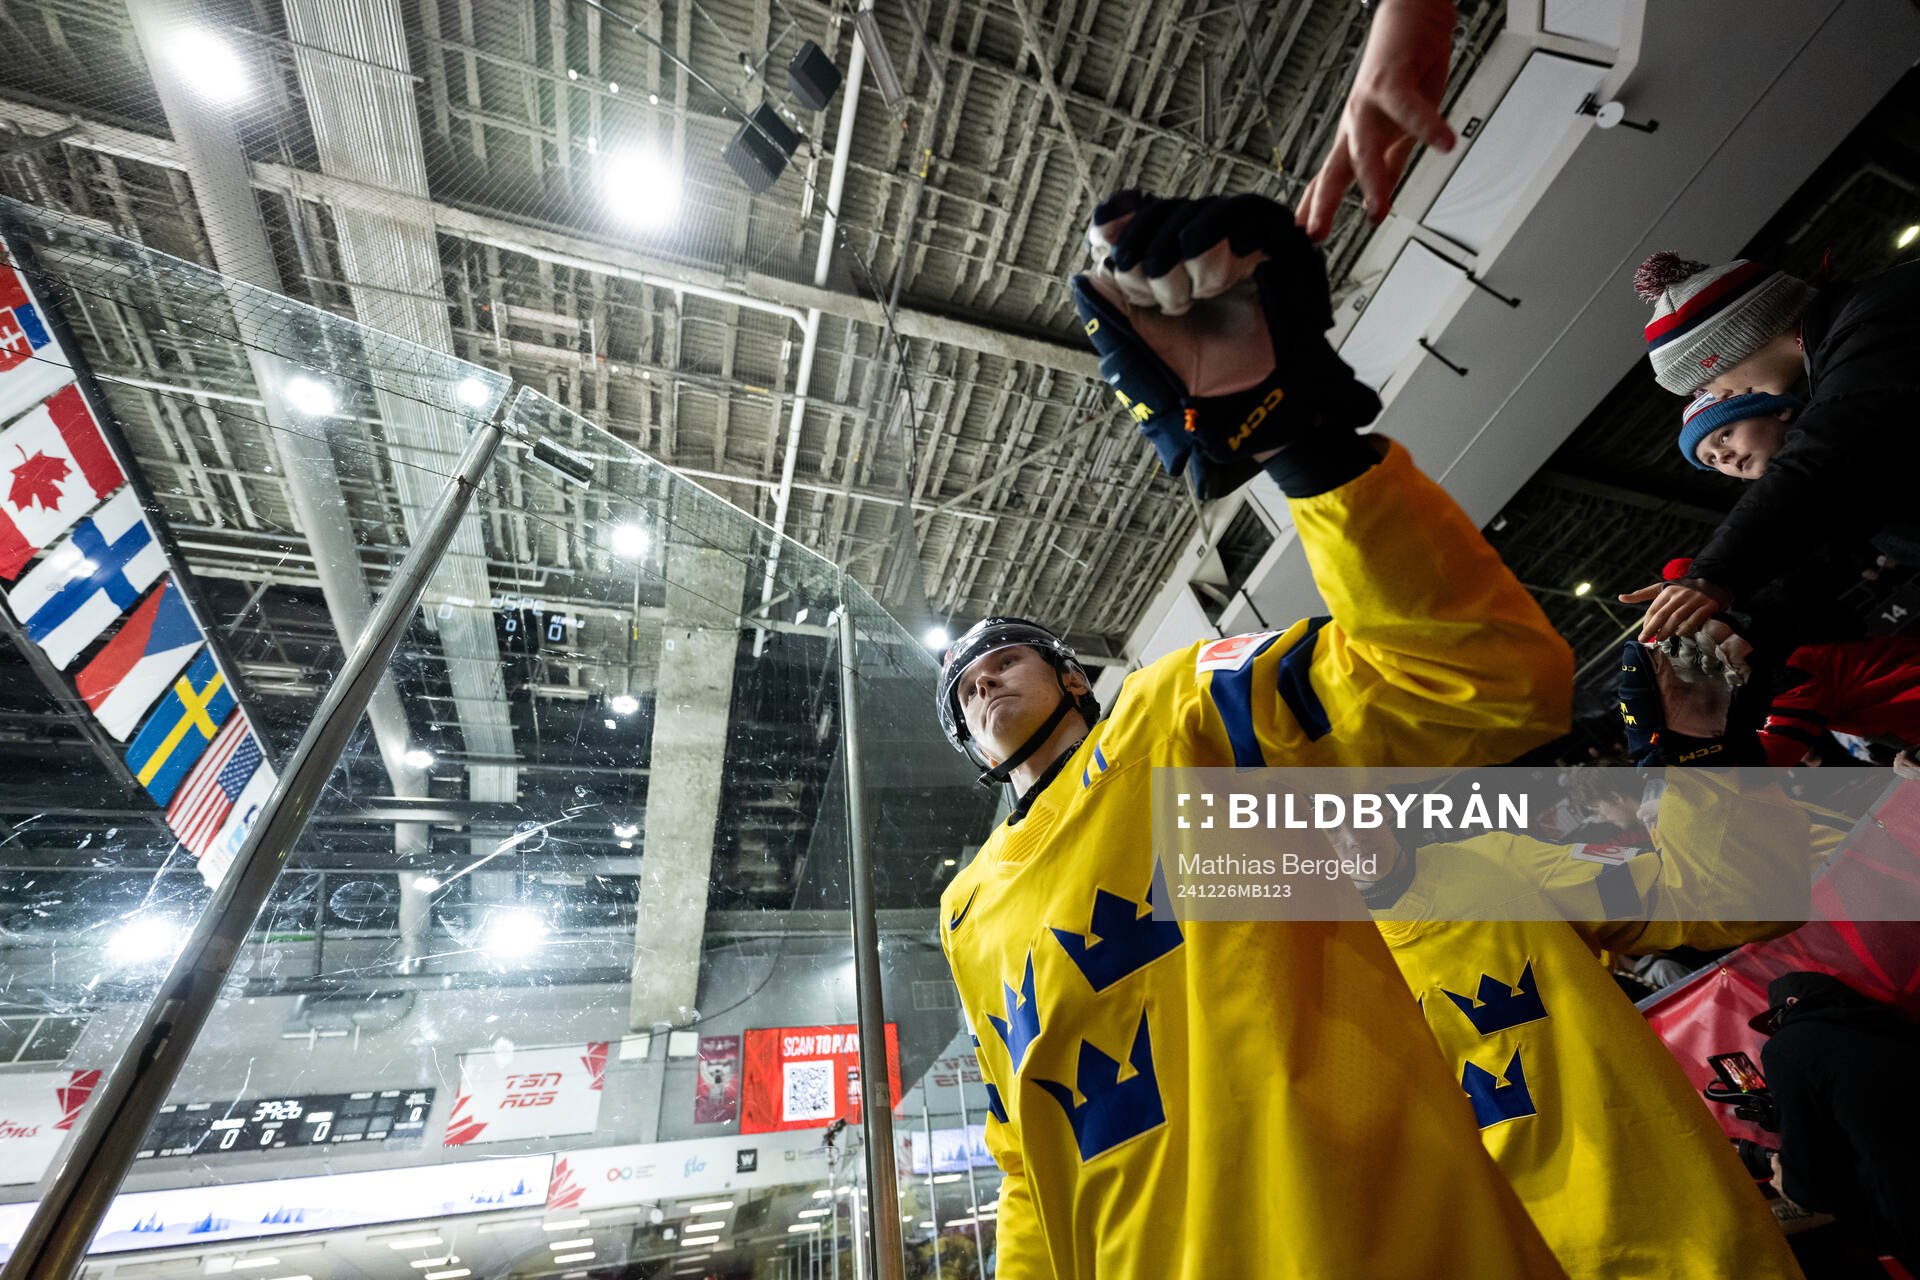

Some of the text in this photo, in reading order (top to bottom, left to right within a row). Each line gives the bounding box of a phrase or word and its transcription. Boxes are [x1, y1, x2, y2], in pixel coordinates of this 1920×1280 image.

[1228, 388, 1284, 450] CCM
[1881, 604, 1907, 623] 14
[1679, 745, 1722, 763] CCM
[783, 1036, 815, 1056] SCAN
[815, 1034, 831, 1055] TO
[506, 1072, 562, 1089] TSN
[220, 1129, 240, 1149] 0
[313, 1122, 331, 1141] 0
